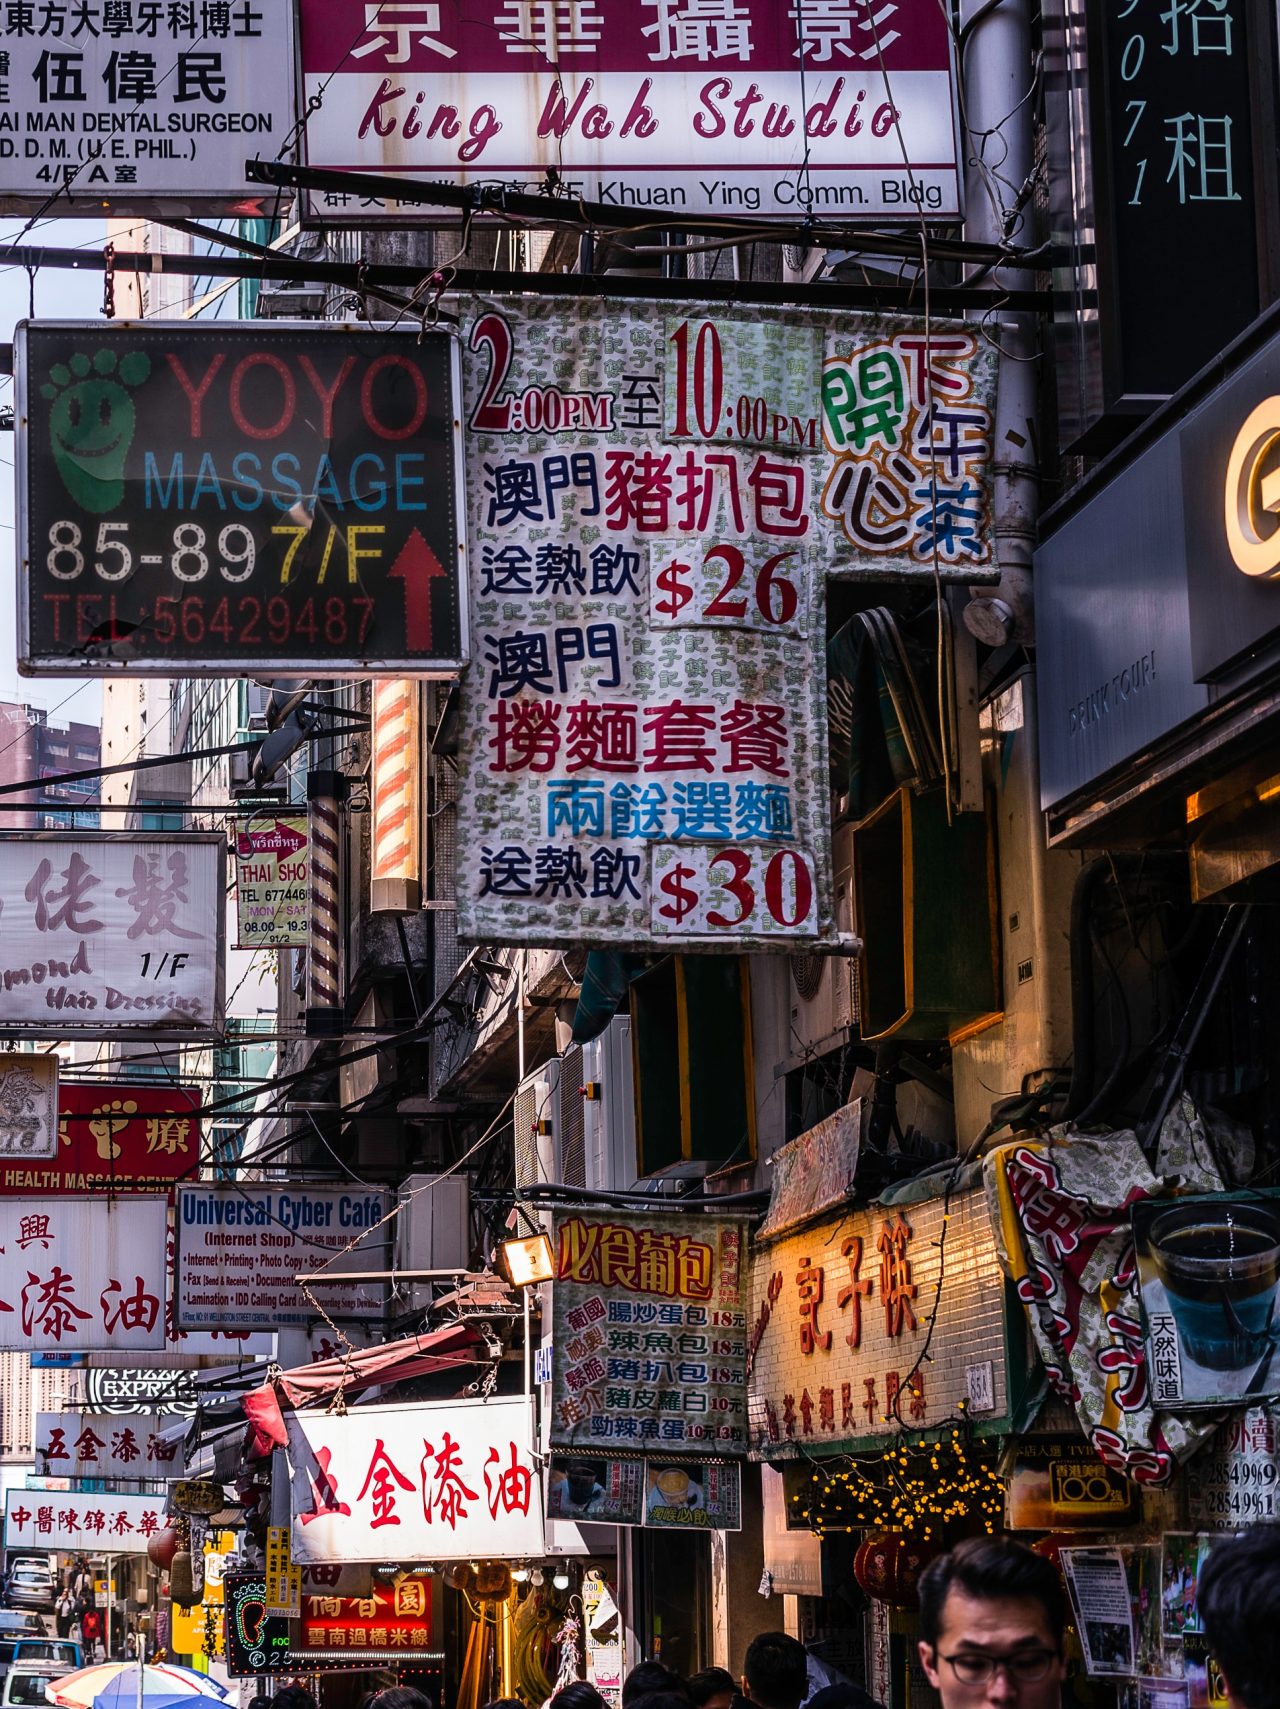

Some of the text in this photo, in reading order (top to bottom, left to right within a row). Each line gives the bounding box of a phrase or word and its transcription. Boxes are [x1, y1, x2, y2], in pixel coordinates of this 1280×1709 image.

[32, 50, 227, 104] 伍偉民
[26, 113, 75, 133] MAN
[358, 76, 902, 162] King Wah Studio
[598, 181, 686, 205] Khuan
[700, 181, 761, 209] Ying
[773, 180, 870, 205] Comm.
[880, 180, 942, 208] Bldg
[165, 352, 428, 441] YOYO
[144, 450, 428, 512] MASSAGE
[483, 449, 809, 537] 澳門豬扒包
[46, 520, 386, 585] 85-89 7/F
[480, 542, 641, 597] 送熱飲
[655, 544, 800, 626] $26
[484, 622, 621, 699] 澳門
[488, 698, 791, 778] 撈麵套餐
[239, 863, 308, 883] THAI SHO
[478, 844, 642, 900] 送熱飲
[240, 889, 260, 902] TEL
[658, 848, 813, 928] $30
[248, 906, 275, 917] MON
[244, 922, 275, 933] 08.00
[140, 952, 190, 982] 1/F
[45, 987, 203, 1017] Hair Dressing
[4, 1169, 60, 1189] HEALTH
[183, 1193, 383, 1231] Universal Cyber Café
[204, 1231, 296, 1248] (Internet Shop)
[187, 1252, 328, 1270] Internet Printing Photo Copy Scan
[558, 1217, 714, 1300] 必食葡包
[187, 1272, 202, 1286] Fax
[187, 1291, 297, 1309] Lamination IDD Calling Card
[608, 1302, 708, 1327] 腸炒蛋包
[711, 1311, 745, 1328] 18元
[608, 1330, 744, 1357] 辣魚包 18元
[1151, 1314, 1183, 1401] 天然味道
[607, 1358, 743, 1384] 豬扒包 18元
[308, 1627, 429, 1647] 雲南過橋米線
